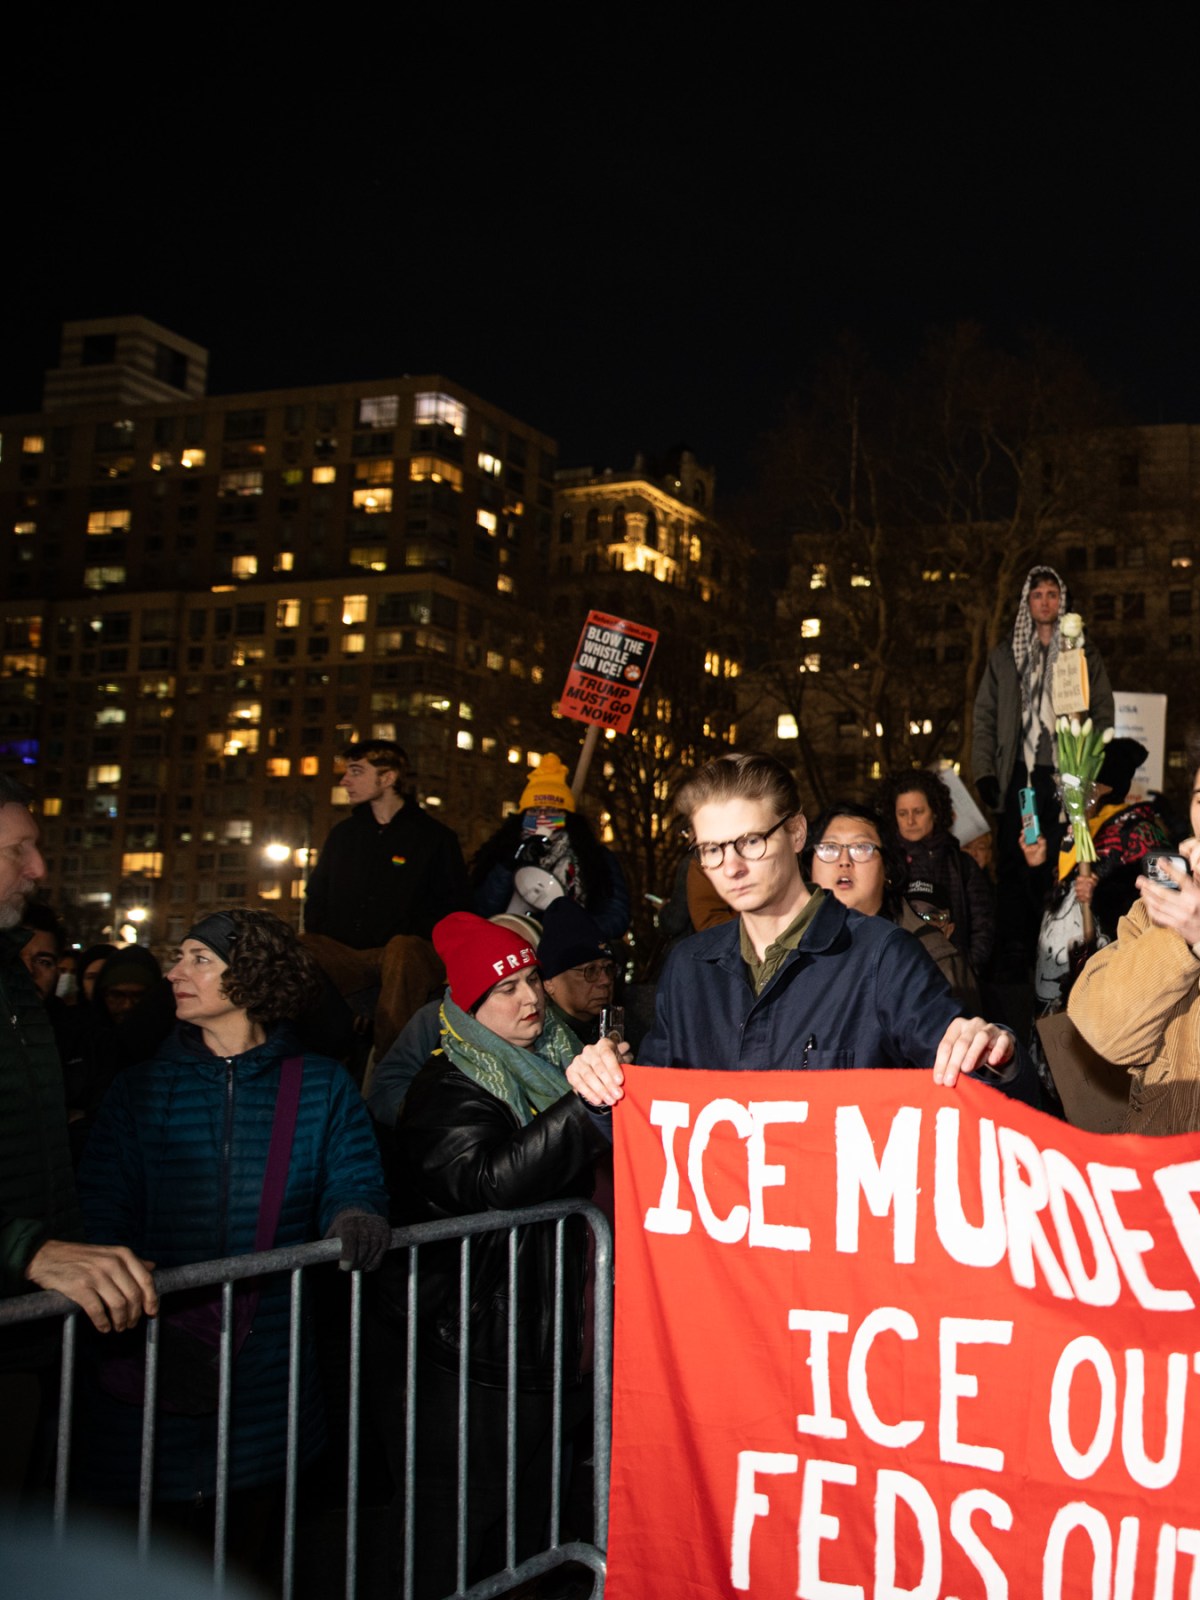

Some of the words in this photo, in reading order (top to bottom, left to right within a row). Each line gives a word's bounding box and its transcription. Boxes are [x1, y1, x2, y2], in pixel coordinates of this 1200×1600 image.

[583, 640, 630, 665] WHISTLE
[587, 626, 623, 648] BLOW
[624, 637, 645, 656] THE
[579, 653, 596, 670] ON
[597, 659, 623, 678] ICE!
[566, 686, 608, 707] MUST
[610, 700, 632, 714] GO
[579, 675, 630, 699] TRUMP
[580, 704, 622, 726] NOW!
[644, 1098, 811, 1251] ICE
[789, 1307, 1013, 1471] ICE
[731, 1450, 1013, 1600] FEDS
